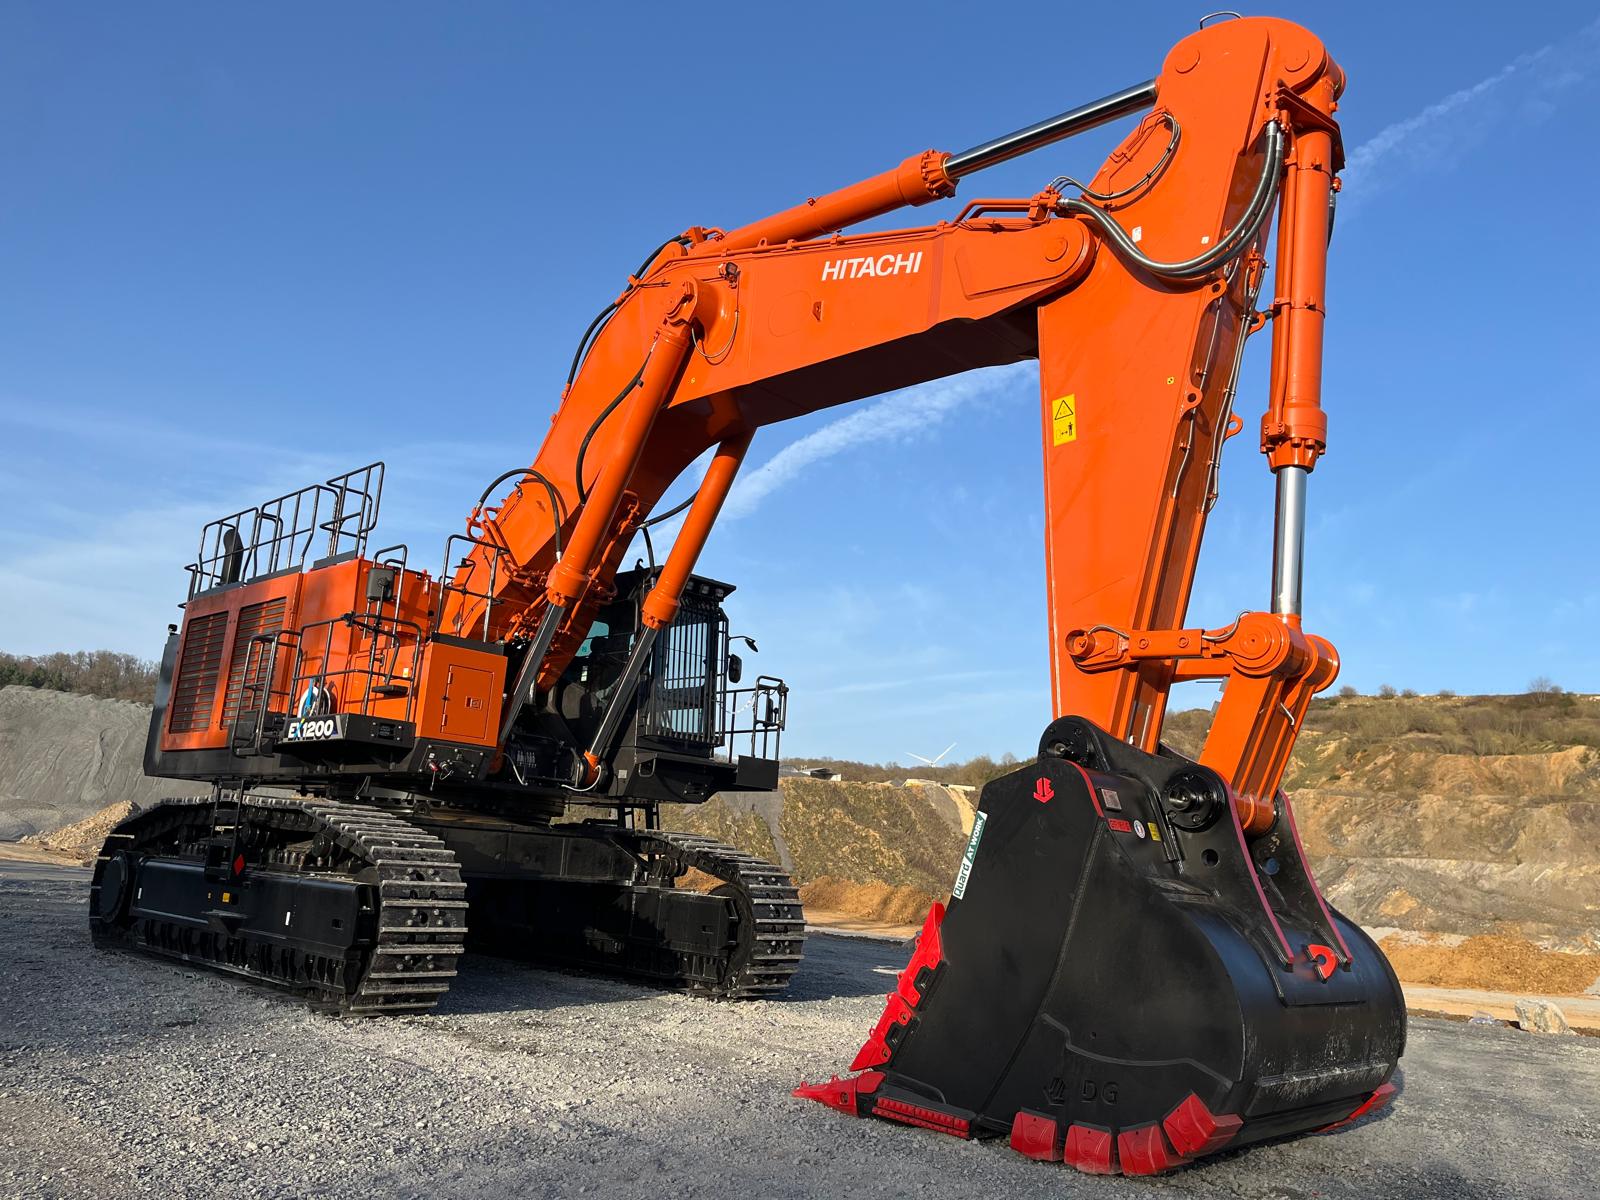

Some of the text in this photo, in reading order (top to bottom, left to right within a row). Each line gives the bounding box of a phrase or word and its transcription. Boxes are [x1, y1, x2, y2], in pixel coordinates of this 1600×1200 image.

[821, 251, 923, 281] HITACHI
[288, 719, 334, 738] EX1200
[954, 817, 984, 897] Quard AT WORK
